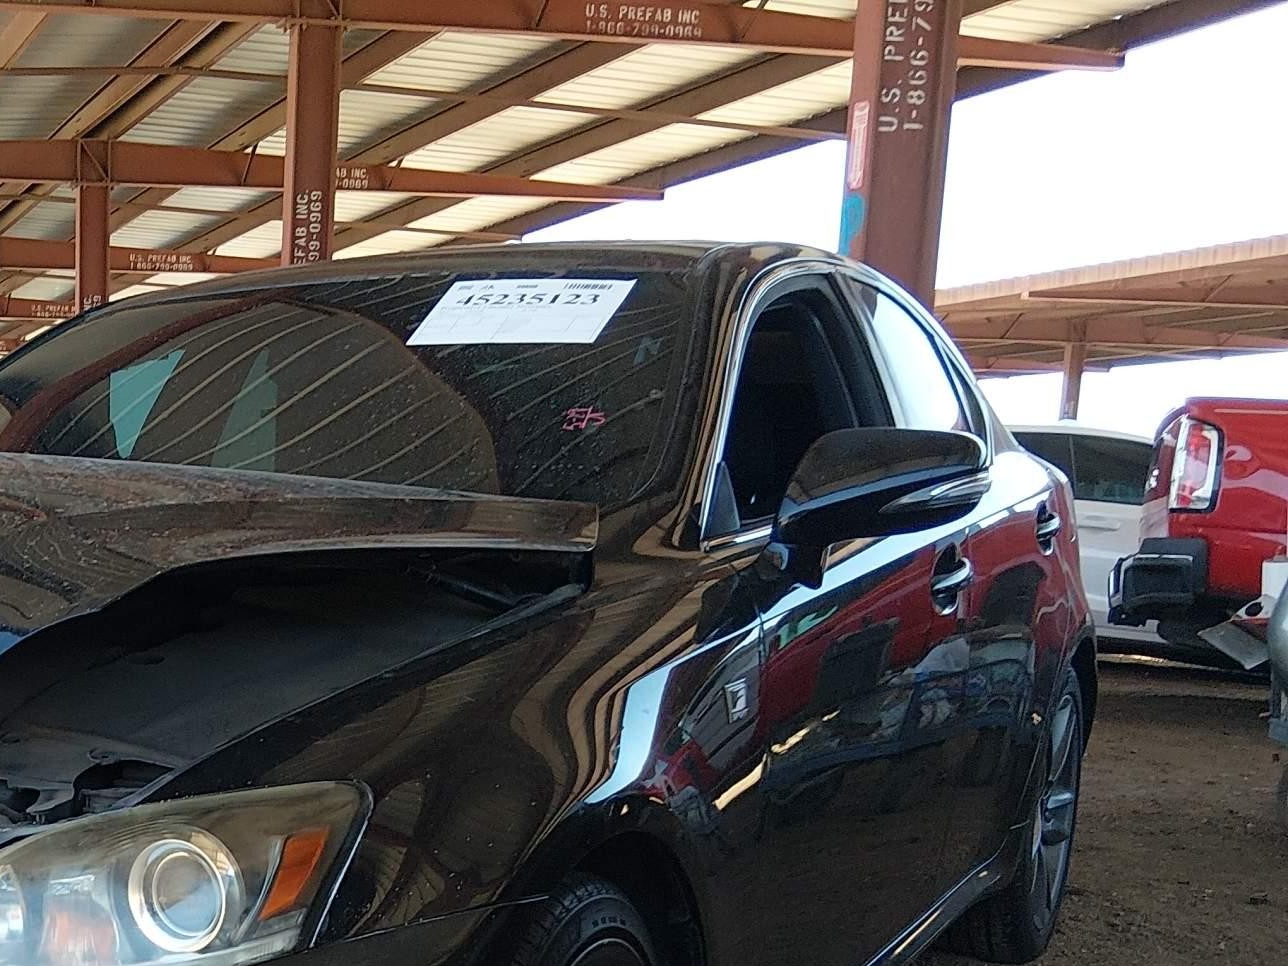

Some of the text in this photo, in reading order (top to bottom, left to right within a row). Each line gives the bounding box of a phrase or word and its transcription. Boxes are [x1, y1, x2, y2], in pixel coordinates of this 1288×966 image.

[585, 3, 612, 19] U.S.
[618, 5, 672, 22] PREFAB
[878, 0, 910, 133] U.S. PRE
[295, 189, 310, 219] INC.
[456, 293, 601, 306] 45235123
